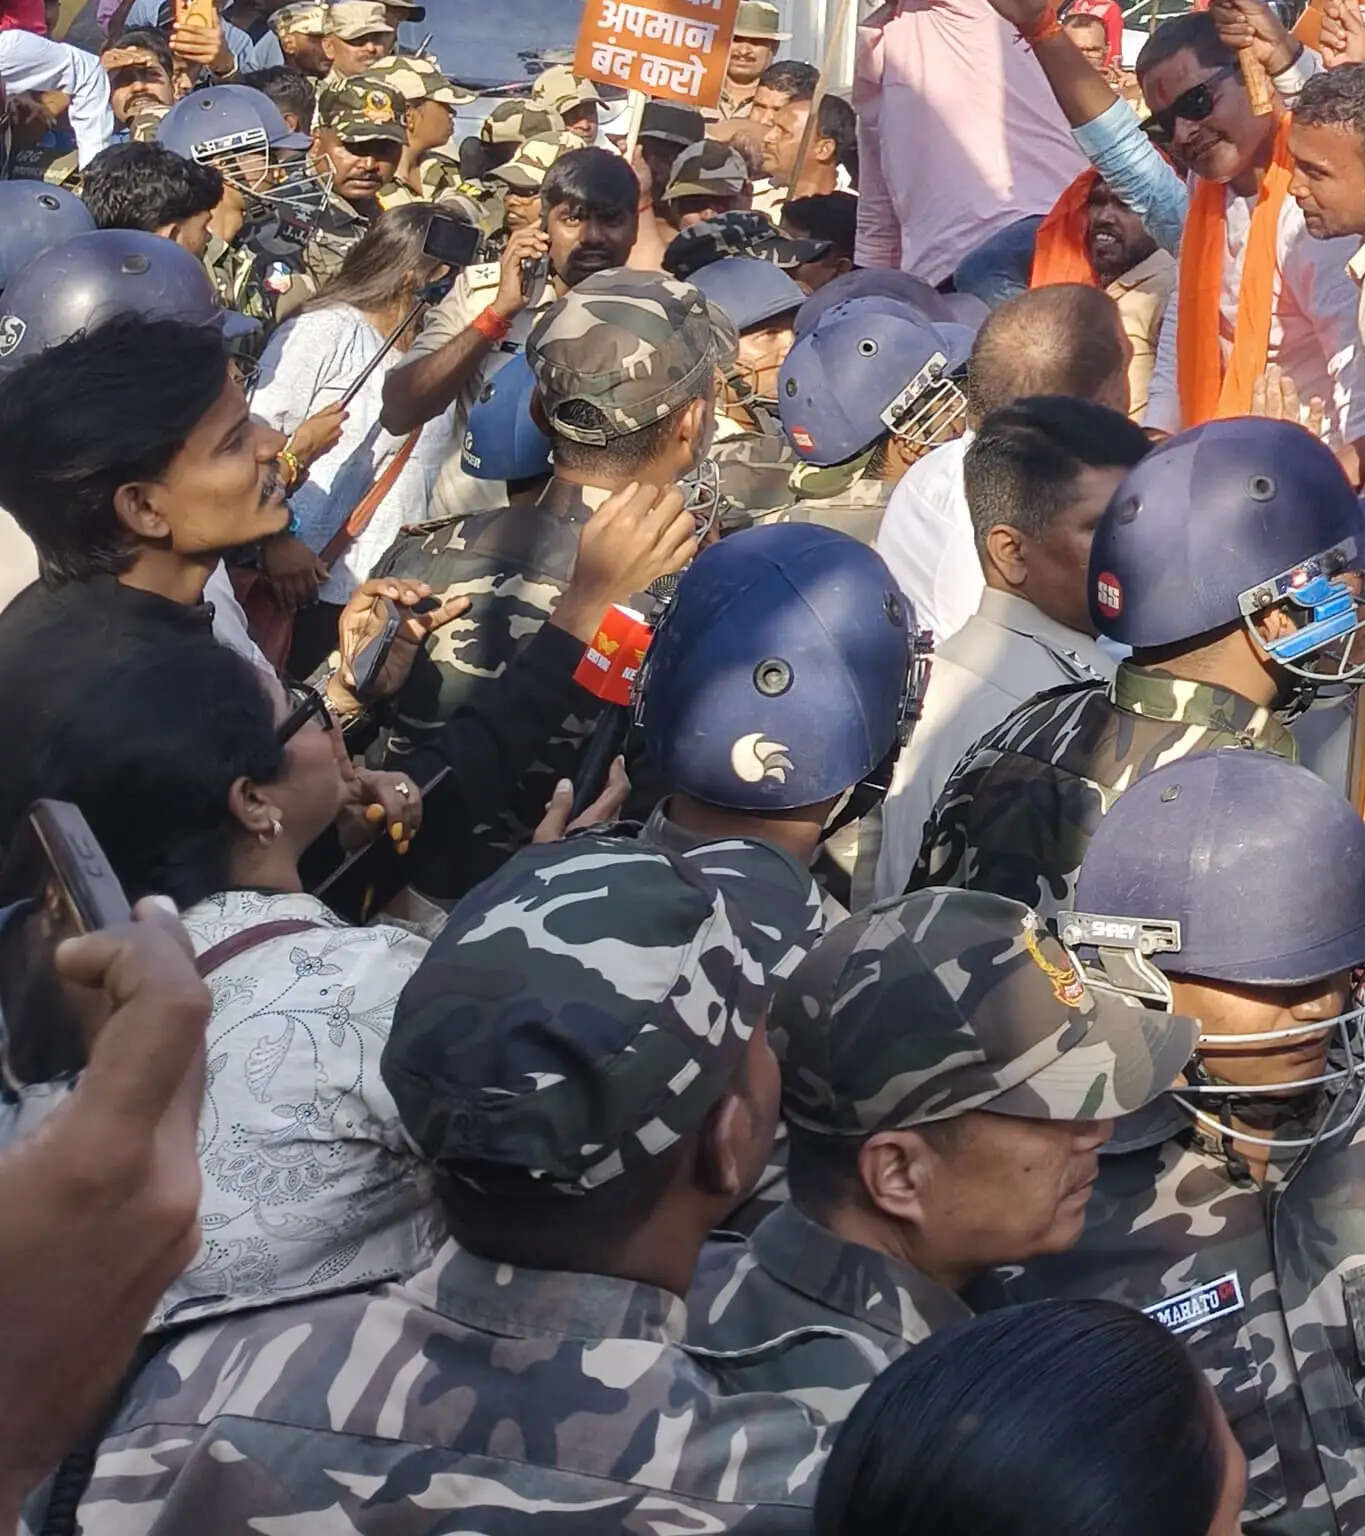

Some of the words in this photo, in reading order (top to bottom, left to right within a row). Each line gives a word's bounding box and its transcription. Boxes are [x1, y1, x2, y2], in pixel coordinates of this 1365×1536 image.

[597, 0, 720, 54] अपमान
[592, 36, 637, 80] बंद
[640, 50, 707, 96] करो
[1096, 579, 1121, 611] SS
